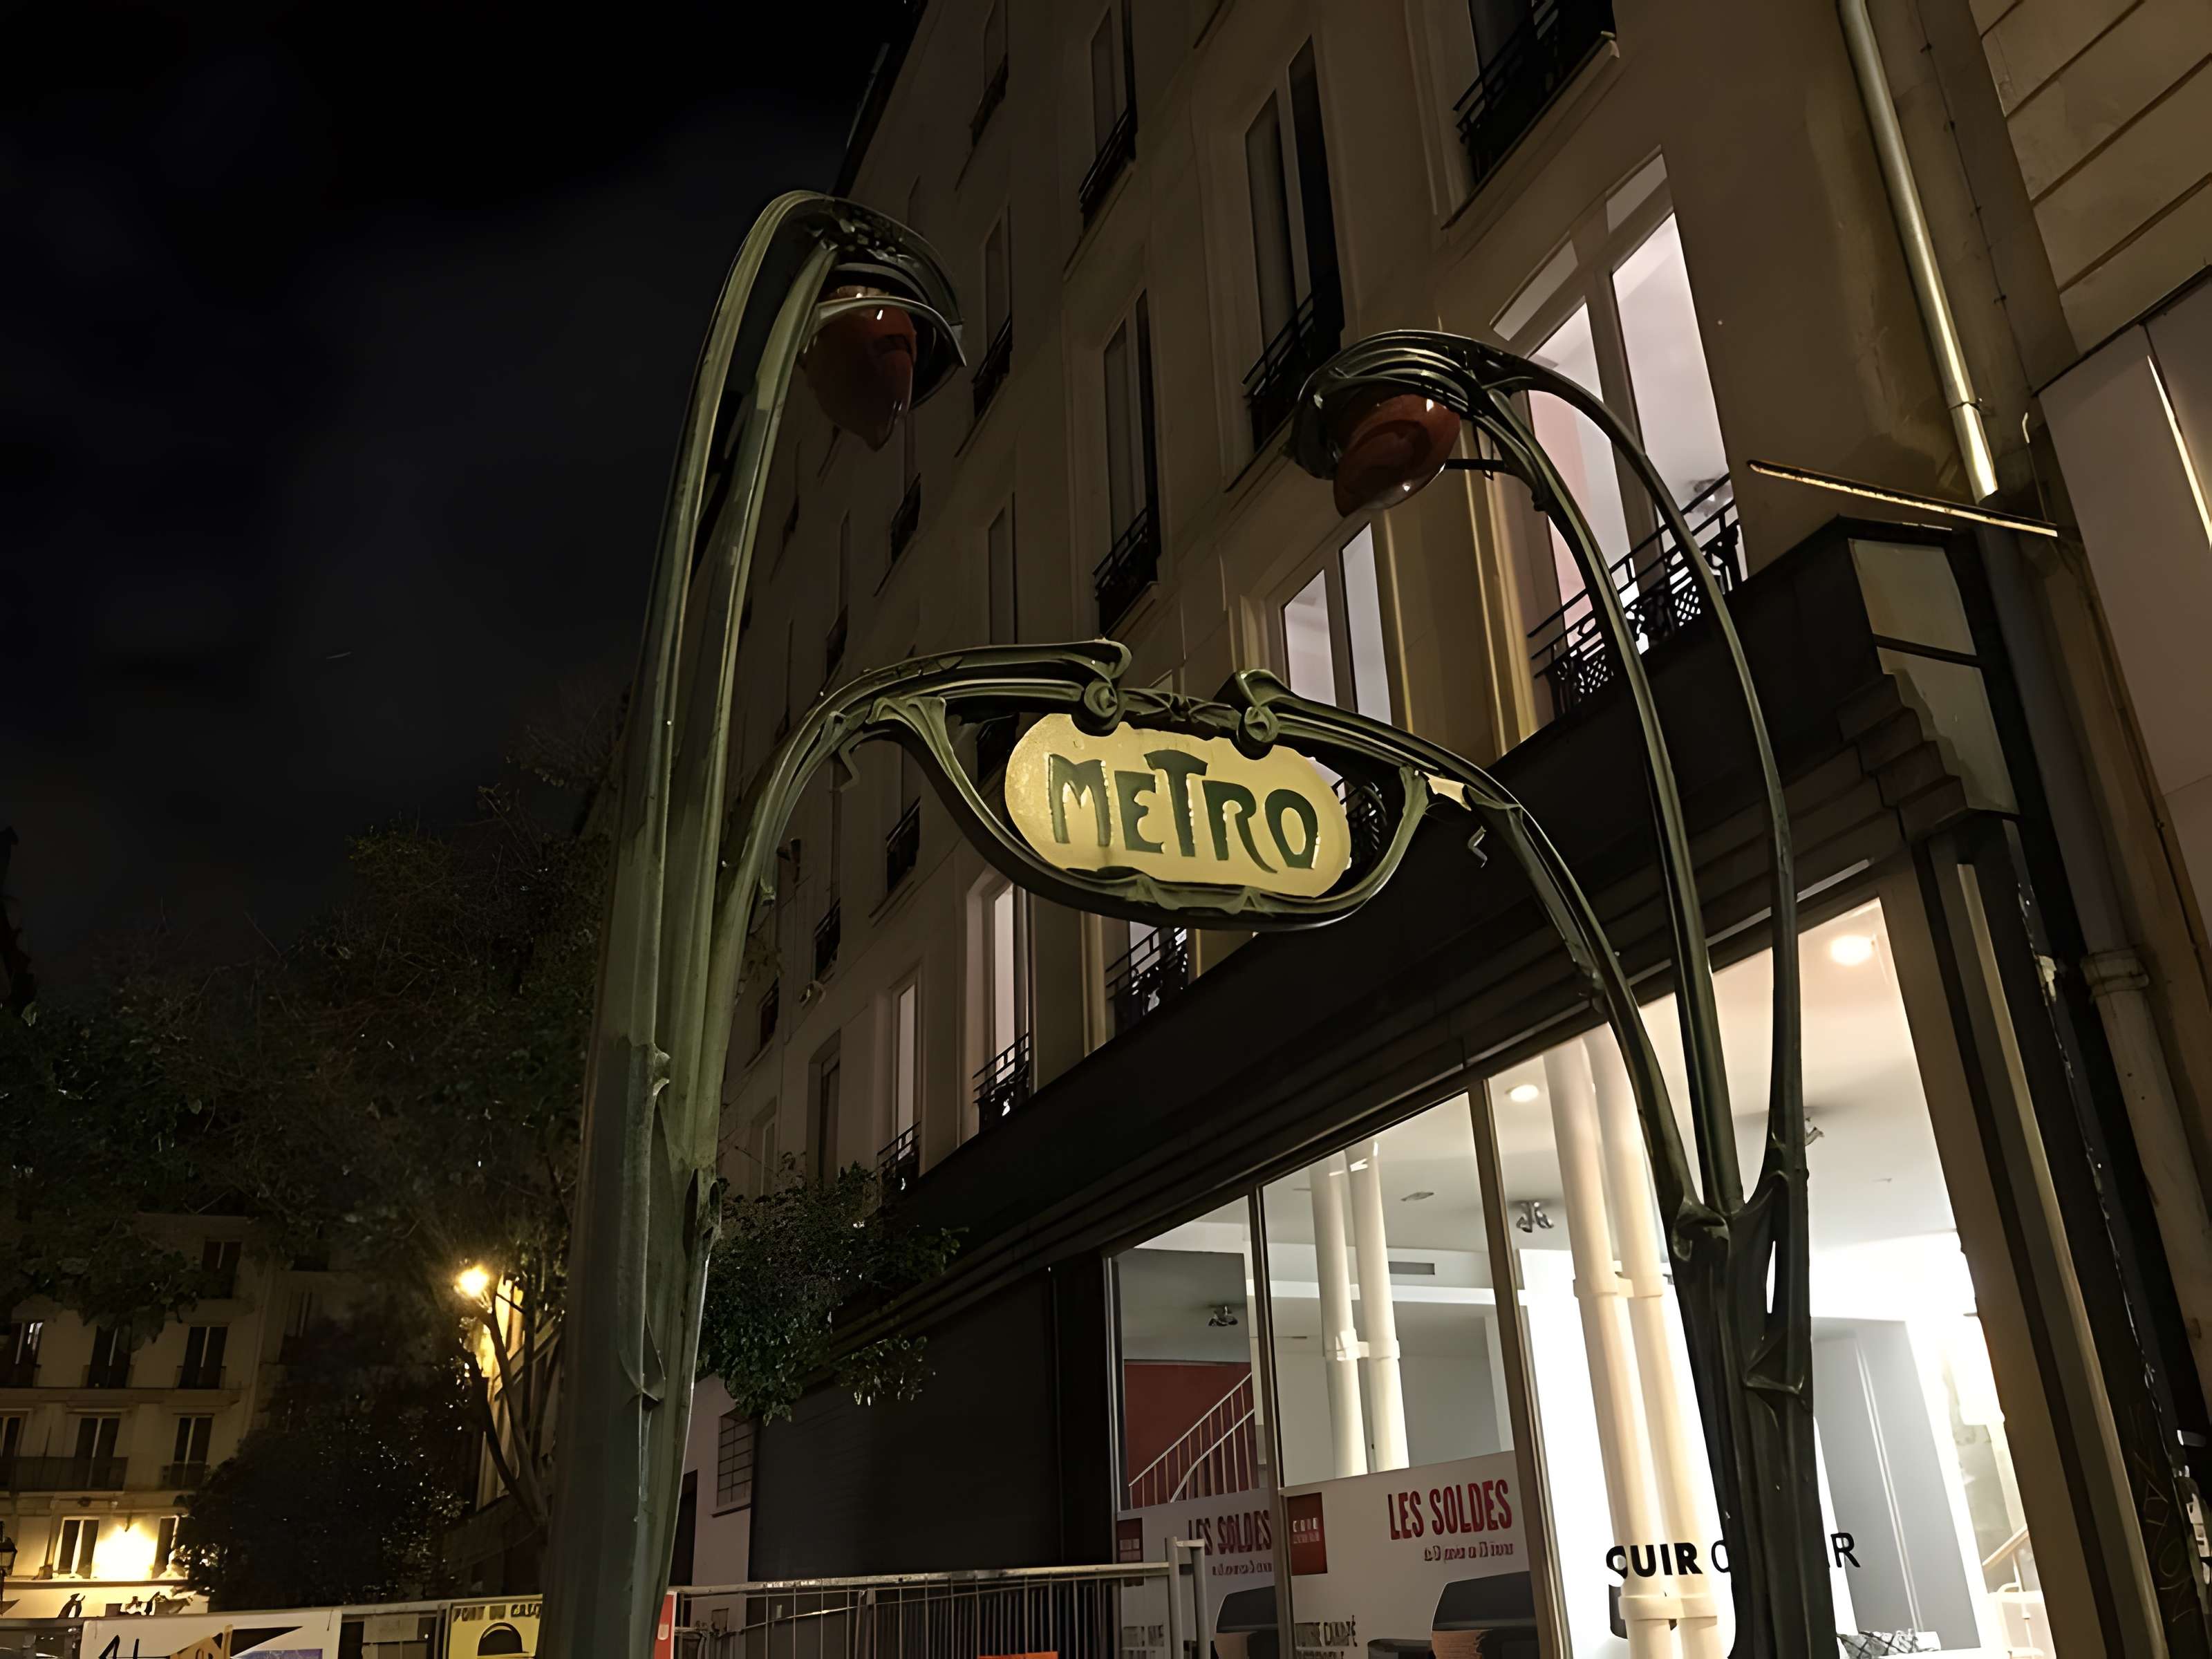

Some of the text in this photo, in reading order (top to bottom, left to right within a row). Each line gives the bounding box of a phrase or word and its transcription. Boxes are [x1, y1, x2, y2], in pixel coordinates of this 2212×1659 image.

[1047, 749, 1320, 874] METRO
[1387, 1479, 1512, 1540] LES SOLDES
